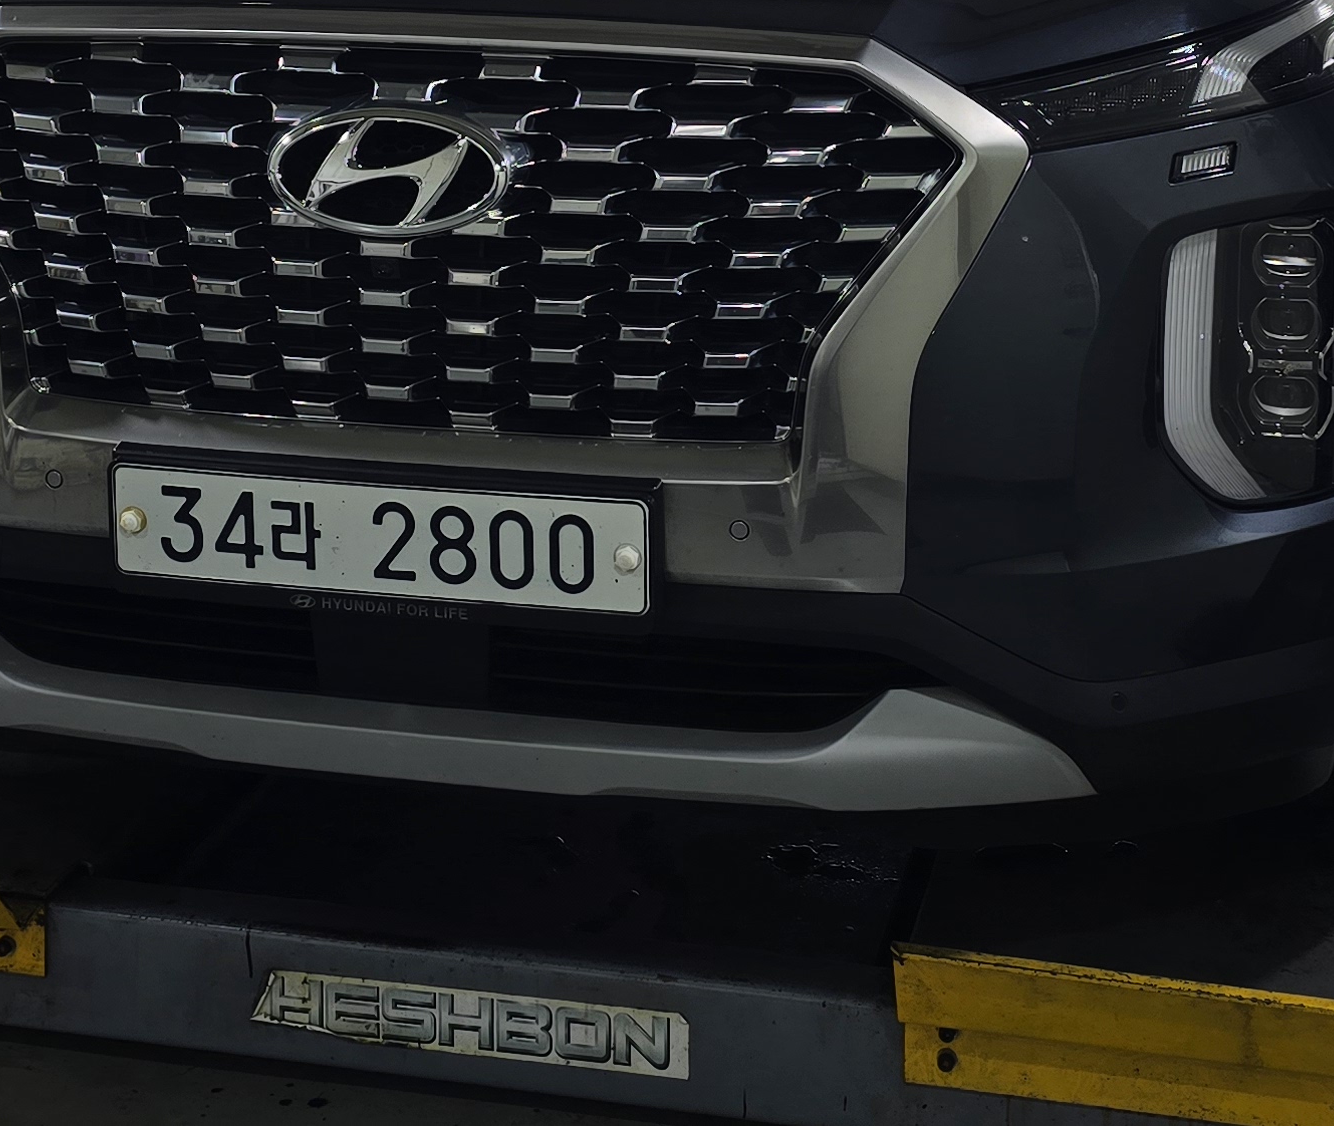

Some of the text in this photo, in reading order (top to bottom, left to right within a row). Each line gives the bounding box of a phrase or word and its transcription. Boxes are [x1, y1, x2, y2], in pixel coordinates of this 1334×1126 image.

[160, 485, 595, 595] 34라 2800
[321, 596, 469, 621] HYUNDAI FOR LIFE
[270, 973, 671, 1071] HESHBON
